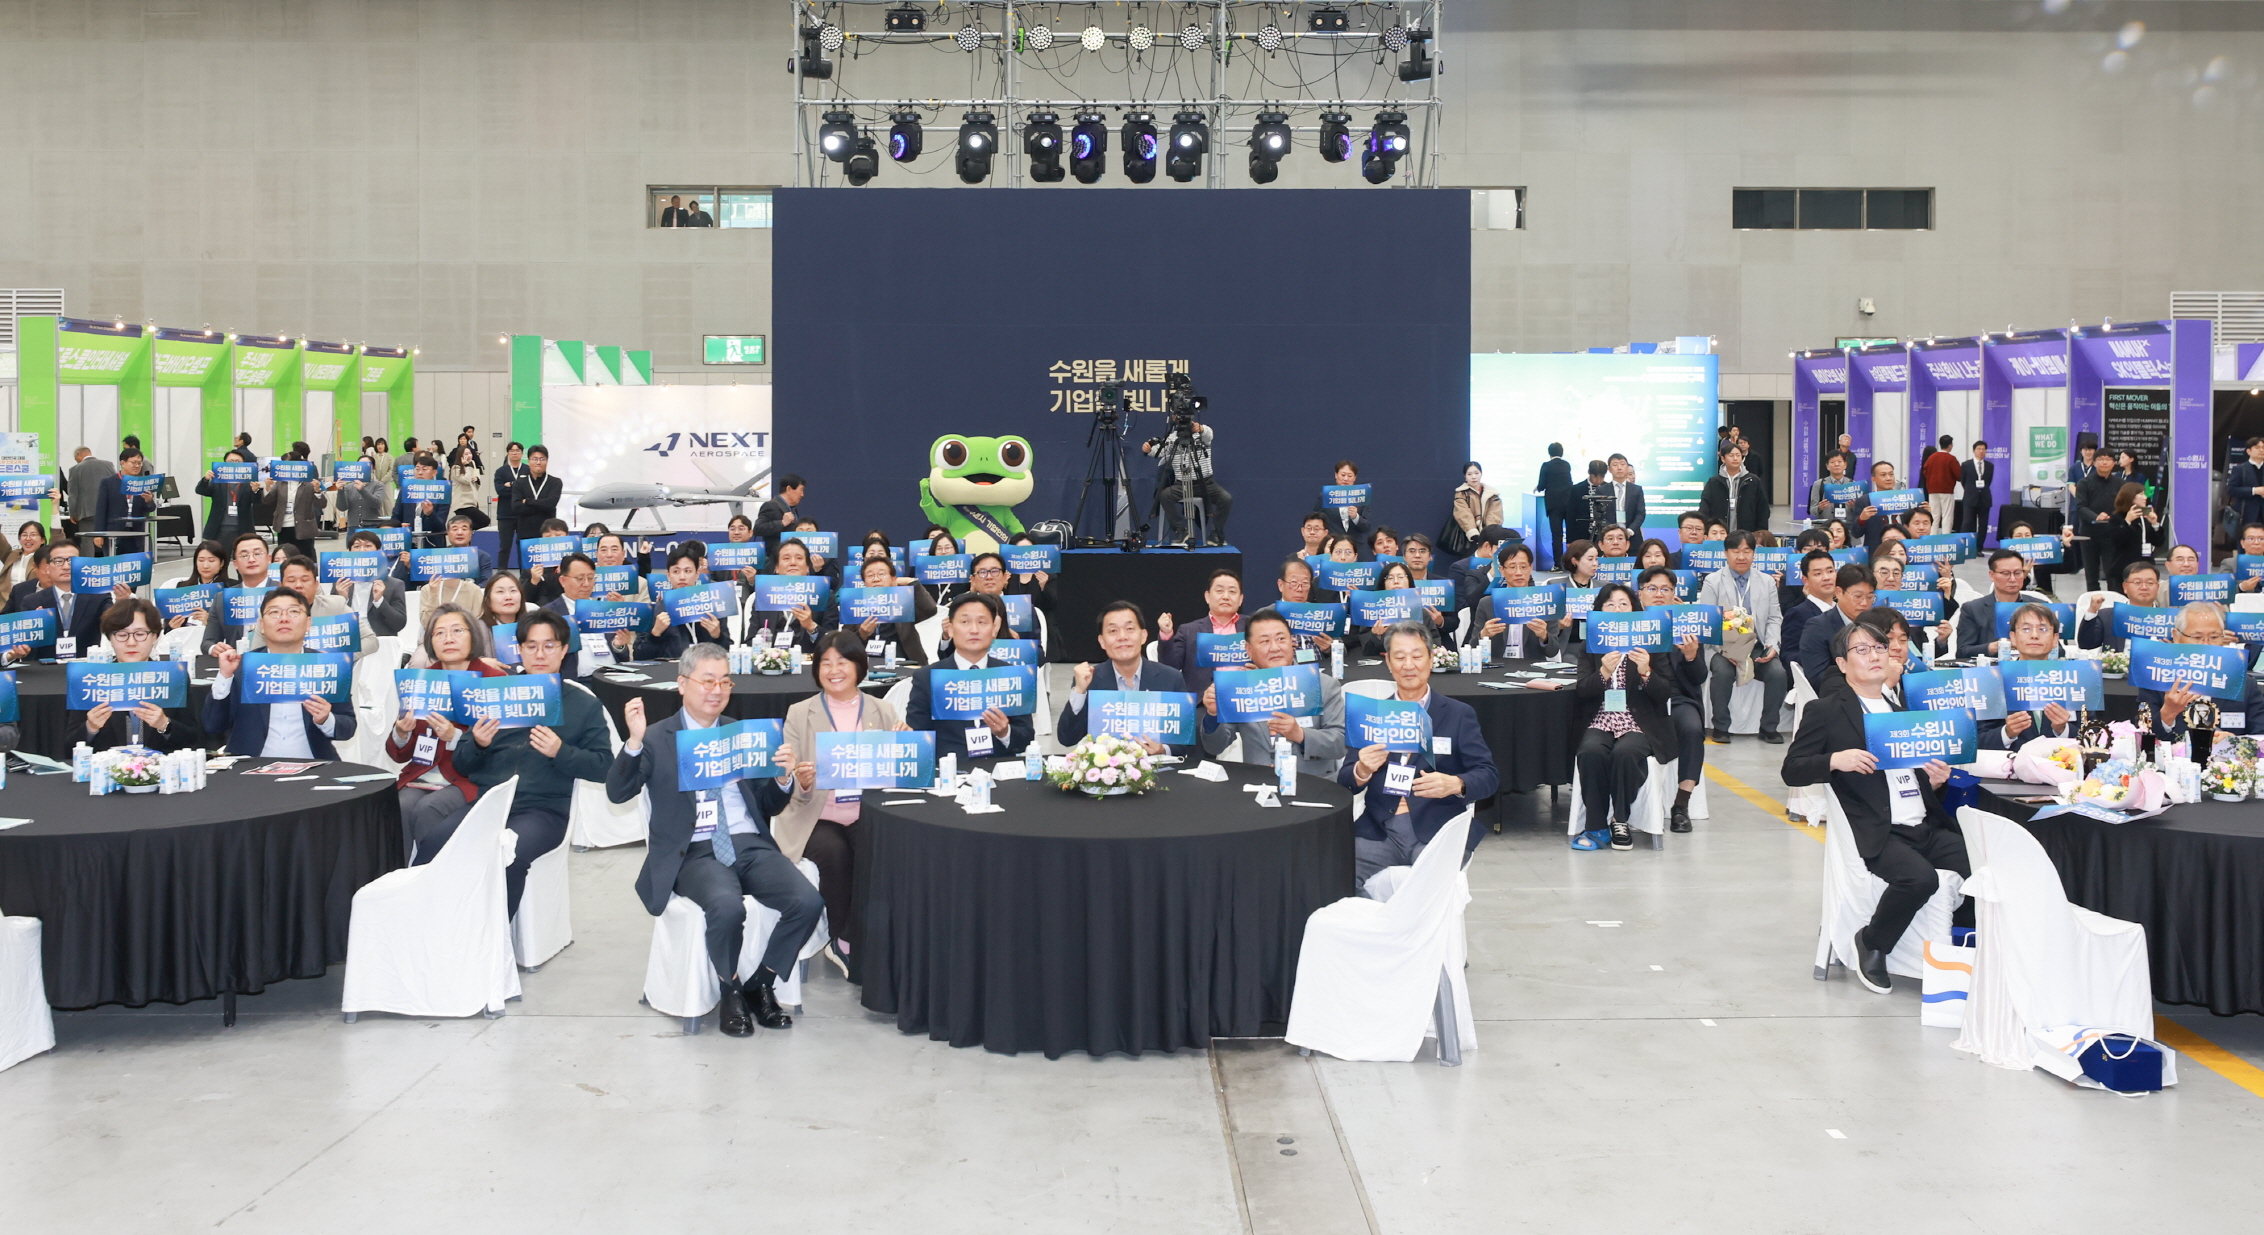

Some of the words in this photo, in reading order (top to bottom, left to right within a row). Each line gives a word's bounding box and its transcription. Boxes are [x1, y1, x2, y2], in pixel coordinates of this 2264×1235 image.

[1049, 359, 1117, 383] 수원을
[1123, 359, 1190, 382] 새롭게
[1926, 362, 1964, 380] 주식회사
[1050, 389, 1116, 413] 기업
[1123, 389, 1172, 413] 빛나
[689, 432, 769, 447] NEXT
[24, 479, 45, 487] 새롭게
[426, 484, 444, 492] 새롭게
[23, 487, 45, 495] 빛나게
[426, 492, 444, 500] 빛나게
[1892, 494, 1914, 502] 수원시
[1879, 502, 1909, 510] 기업인의
[1022, 550, 1047, 560] 수원시
[81, 565, 111, 575] 수원을
[112, 560, 141, 573] 새롭게
[328, 558, 352, 567] 수원을
[354, 557, 377, 566] 새롭게
[1008, 560, 1041, 569] 기업인의
[1042, 559, 1051, 569] 날
[328, 569, 352, 577] 기업을
[354, 568, 377, 577] 빛나게
[81, 577, 111, 587] 기업을
[113, 572, 141, 585] 빛나게
[784, 582, 815, 593] 수원시
[691, 590, 719, 603] 수원시
[767, 594, 807, 605] 기업인의
[809, 594, 819, 605] 날
[868, 594, 898, 604] 수원시
[1377, 596, 1406, 608] 수원시
[1522, 592, 1553, 604] 수원시
[676, 605, 713, 618] 기업인의
[715, 600, 726, 612] 날
[1903, 598, 1931, 609] 수원시
[605, 607, 637, 616] 수원시
[851, 605, 890, 617] 기업인의
[892, 605, 903, 616] 날
[1360, 608, 1398, 620] 기업인의
[1400, 607, 1411, 618] 날
[1504, 605, 1545, 617] 기업인의
[1547, 604, 1557, 615] 날
[1925, 610, 1935, 621] 날
[12, 618, 43, 629] 새롭게
[586, 618, 628, 629] 기업인의
[630, 617, 641, 627] 날
[1678, 611, 1708, 624] 수원시
[322, 622, 349, 635] 새롭게
[1598, 622, 1629, 632] 수원을
[1631, 620, 1661, 632] 새롭게
[1702, 626, 1712, 637] 날
[2124, 623, 2168, 637] 기업인의
[12, 630, 44, 642] 빛나게
[322, 635, 350, 648] 빛나게
[1598, 635, 1629, 646] 기업을
[1632, 633, 1661, 645] 빛나게
[2153, 656, 2172, 666] 제3회
[2174, 653, 2222, 670] 수원시
[256, 664, 296, 679] 수원을
[300, 664, 337, 678] 새롭게
[2035, 670, 2077, 685] 수원시
[82, 673, 124, 686] 수원을
[128, 671, 170, 685] 새롭게
[945, 681, 983, 694] 수원을
[985, 676, 1021, 692] 새롭게
[1254, 676, 1297, 693] 수원시
[2211, 673, 2228, 689] 날
[256, 681, 296, 695] 기업을
[300, 681, 337, 695] 빛나게
[1945, 678, 1978, 694] 수원시
[82, 688, 124, 702] 기업을
[128, 686, 169, 700] 빛나게
[462, 688, 500, 703] 수원을
[504, 686, 544, 701] 새롭게
[2012, 686, 2067, 702] 기업인의
[2070, 687, 2086, 702] 날
[945, 697, 983, 711] 기업을
[1231, 693, 1287, 713] 기업인의
[1290, 692, 1305, 708] 날
[1971, 695, 1987, 710] 날
[465, 704, 502, 719] 기업을
[505, 703, 546, 718] 빛나게
[1102, 702, 1140, 717] 수원을
[1143, 703, 1180, 717] 새롭게
[1102, 719, 1140, 733] 기업을
[1143, 720, 1180, 735] 빛나게
[1890, 730, 1909, 738] 제3회
[1910, 720, 1954, 738] 수원시
[971, 735, 988, 744] VIP
[1360, 724, 1420, 745] 기업인의
[1420, 730, 1427, 752] 날
[419, 744, 433, 753] VIP
[694, 739, 730, 758] 수원을
[732, 732, 766, 750] 새롭게
[831, 744, 873, 759] 수원을
[877, 743, 917, 758] 새롭게
[1885, 739, 1945, 758] 기업인의
[1949, 739, 1962, 755] 날
[694, 760, 731, 778] 기업을
[732, 751, 766, 771] 빛나게
[831, 763, 873, 778] 기업을
[877, 762, 917, 778] 빛나게
[1391, 773, 1409, 784] VIP
[1896, 775, 1910, 784] VIP
